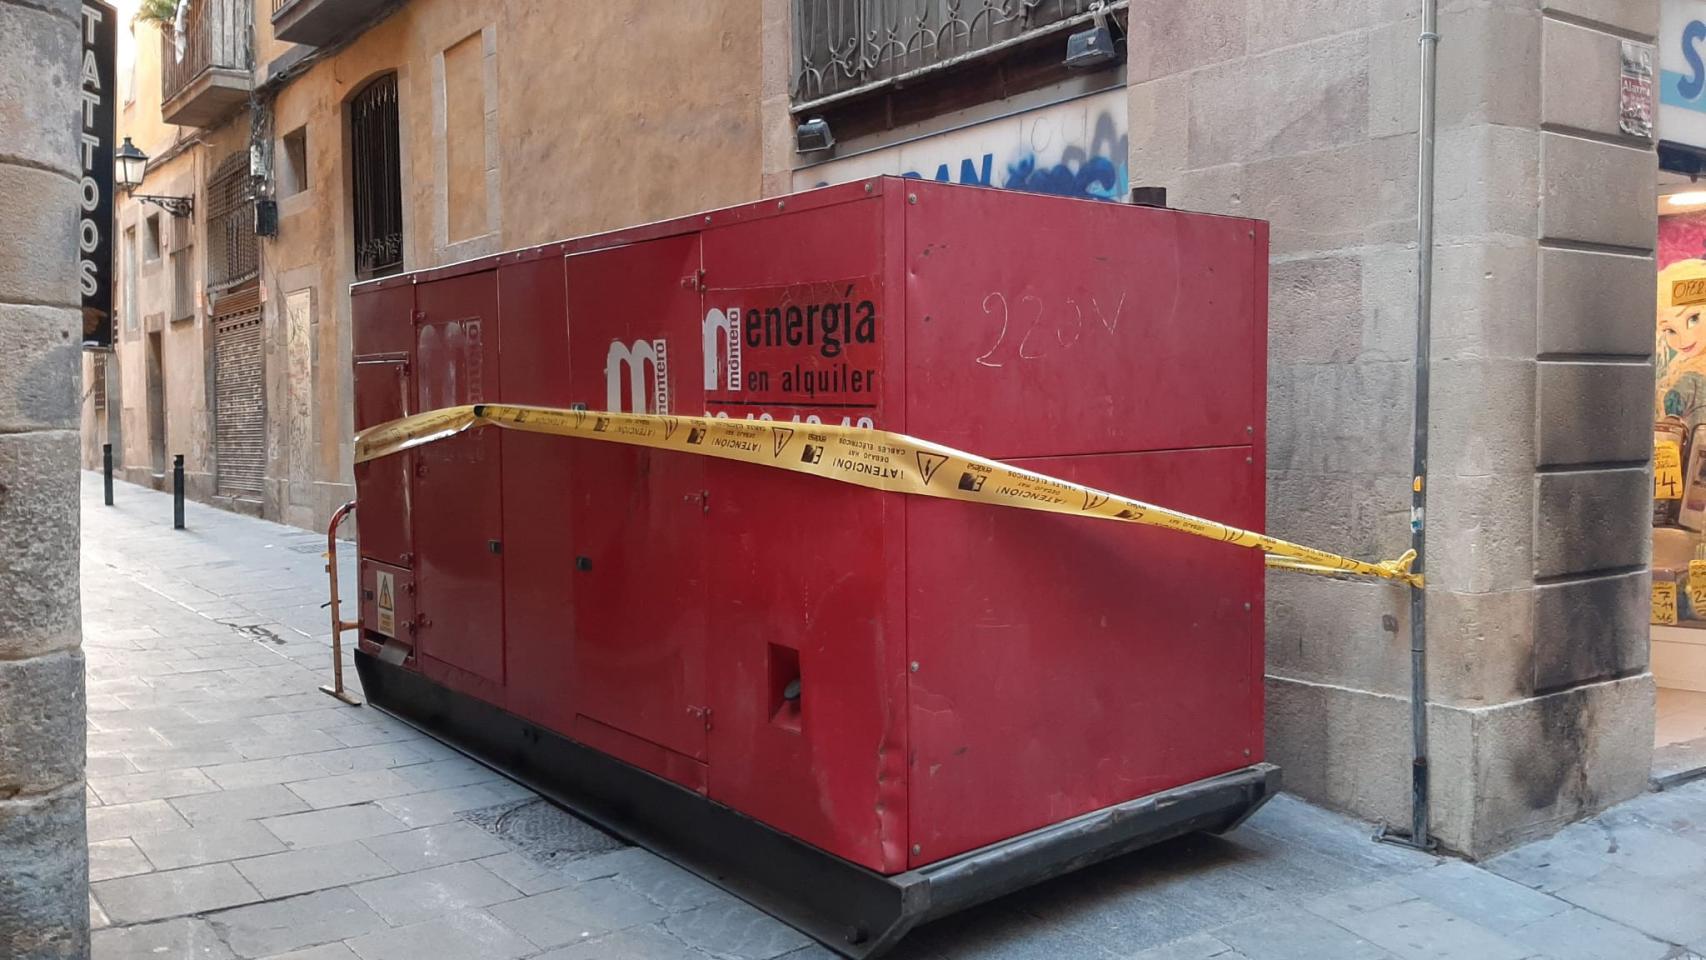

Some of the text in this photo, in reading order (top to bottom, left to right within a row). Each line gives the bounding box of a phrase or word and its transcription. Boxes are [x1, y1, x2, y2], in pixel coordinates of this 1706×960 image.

[80, 3, 102, 296] TATTOOS
[730, 310, 740, 388] montero
[746, 284, 875, 357] energía
[749, 363, 875, 398] en alquiler
